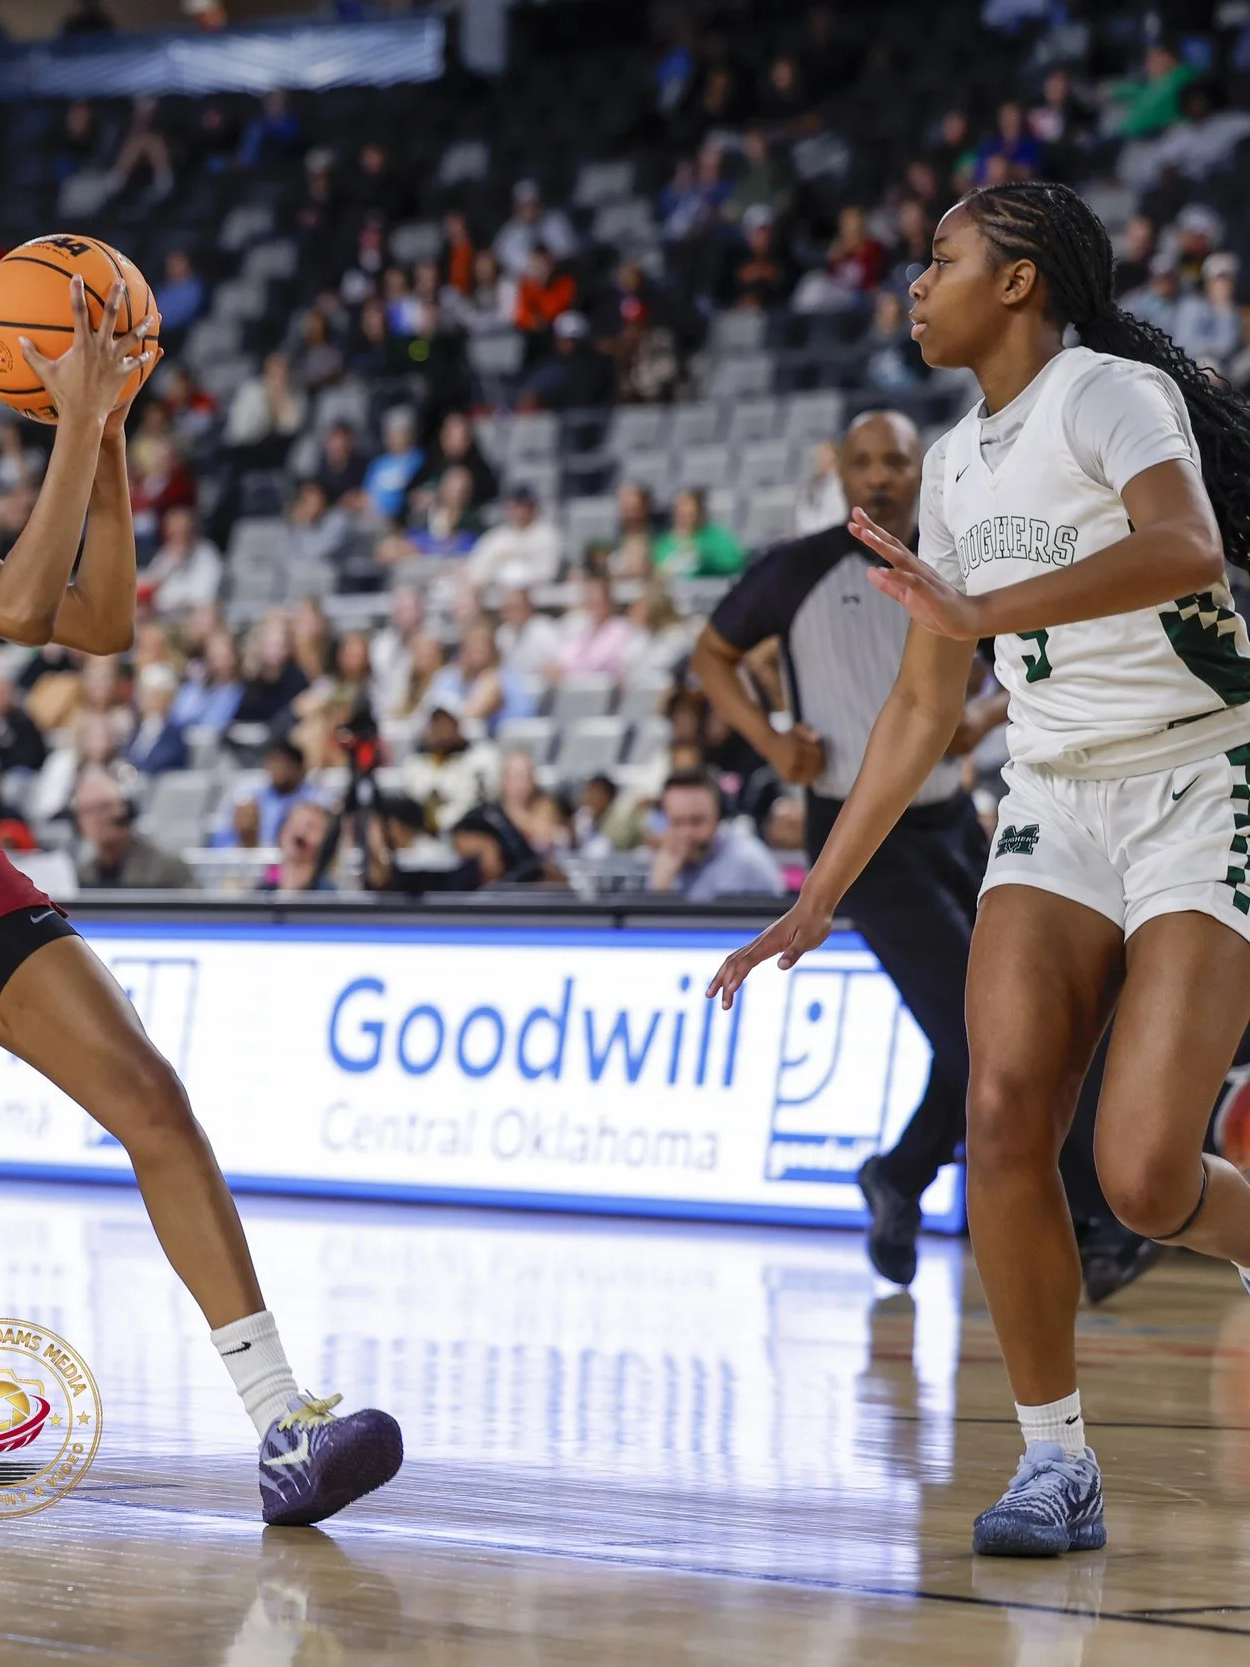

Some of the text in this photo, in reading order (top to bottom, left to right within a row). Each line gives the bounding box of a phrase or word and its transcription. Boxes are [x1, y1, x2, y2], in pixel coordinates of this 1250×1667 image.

[327, 974, 745, 1088] Goodwill
[320, 1098, 721, 1172] Central Oklahoma
